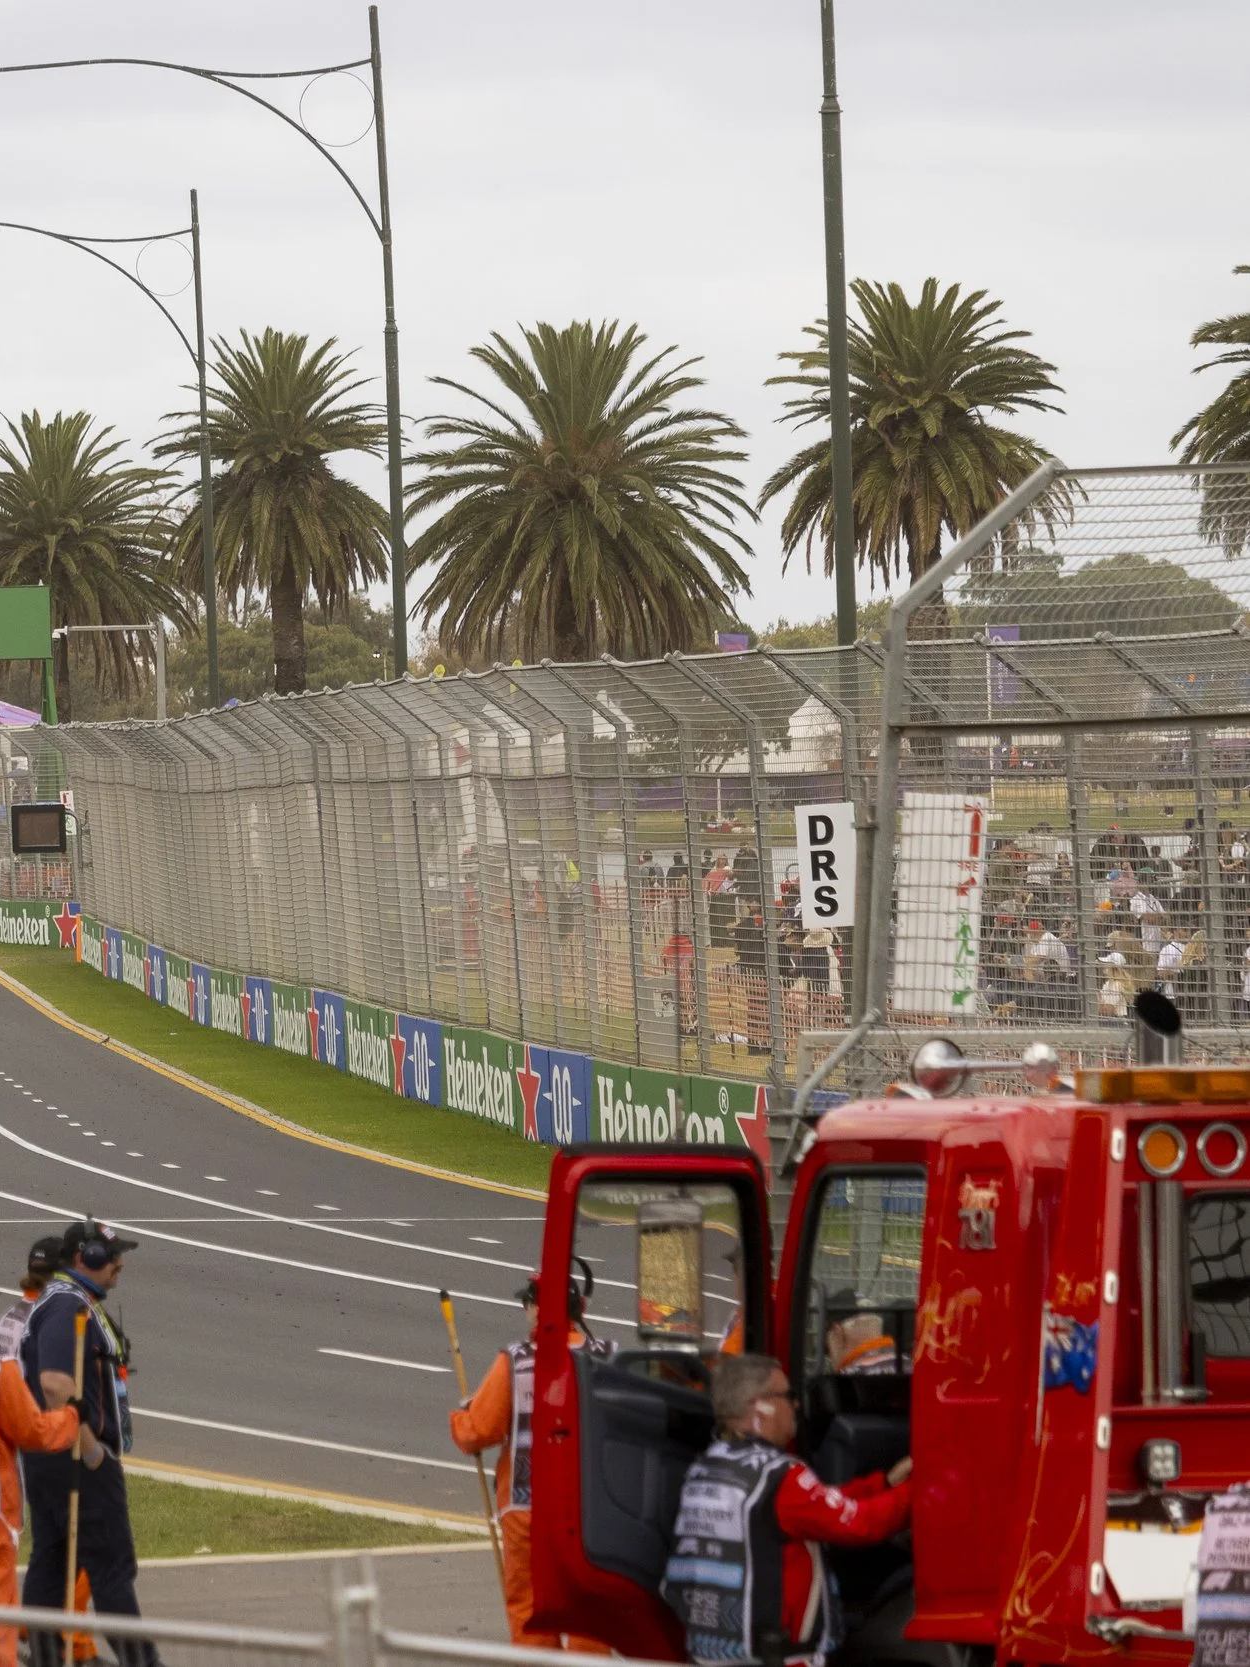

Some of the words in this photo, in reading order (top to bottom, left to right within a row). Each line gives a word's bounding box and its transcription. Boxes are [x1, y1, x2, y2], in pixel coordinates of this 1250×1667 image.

[807, 814, 840, 918] DRS
[345, 1010, 391, 1088] Heineken
[443, 1036, 515, 1128] Heineken
